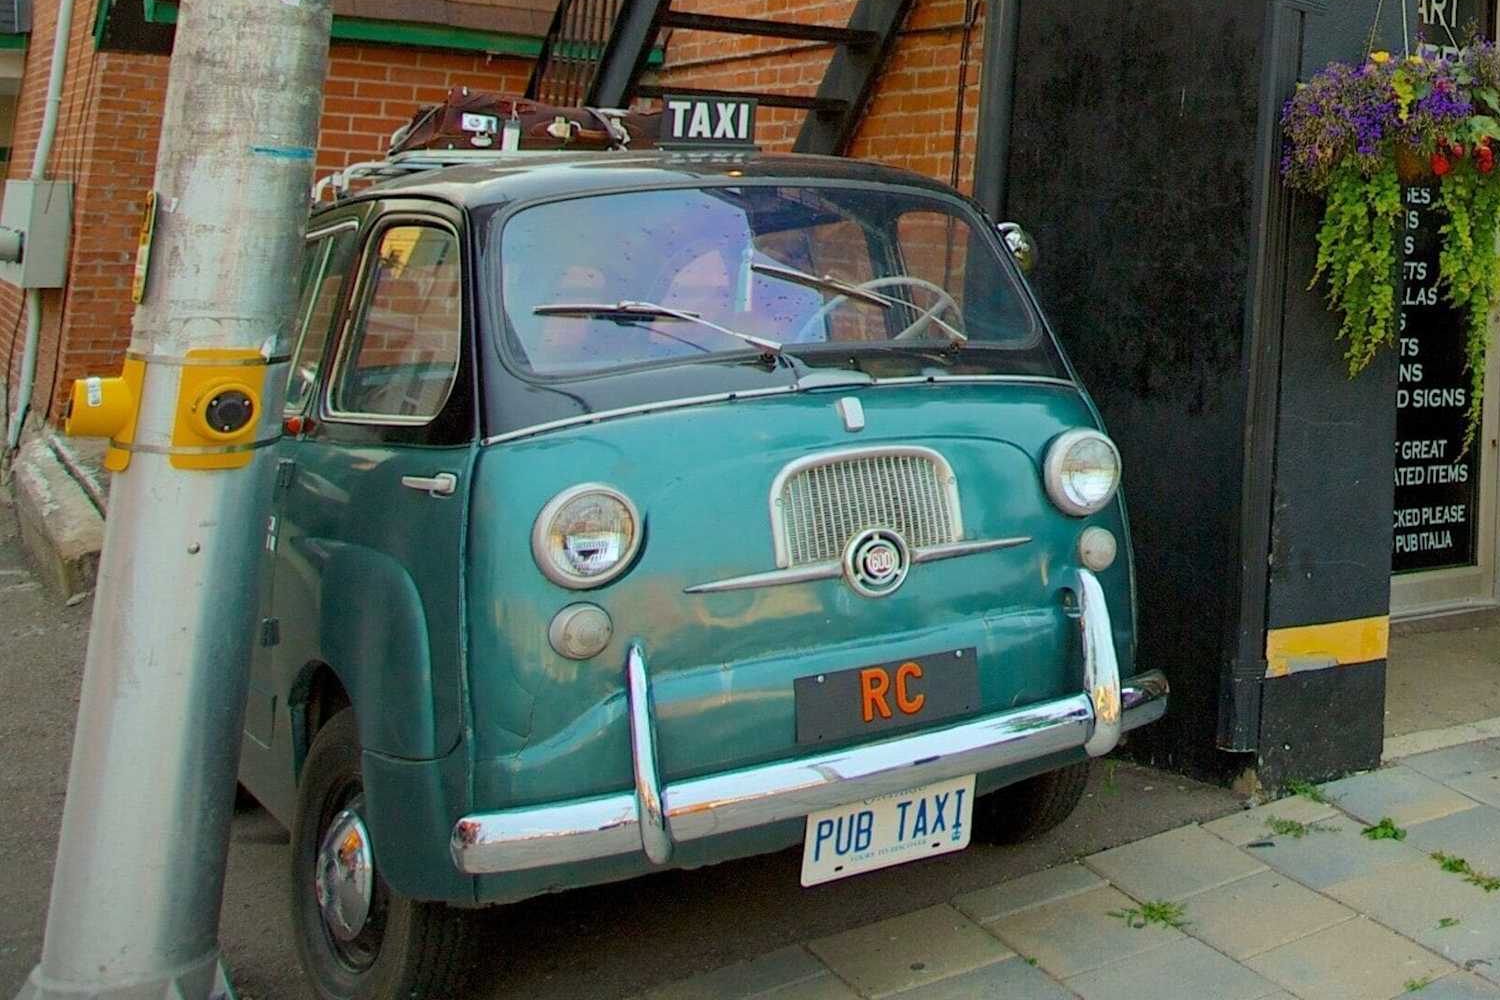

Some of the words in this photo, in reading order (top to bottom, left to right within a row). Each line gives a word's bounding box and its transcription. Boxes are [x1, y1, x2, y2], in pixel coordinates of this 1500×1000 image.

[668, 101, 749, 139] TAXI
[1413, 388, 1466, 408] SIGNS
[1401, 440, 1448, 459] GREAT
[1427, 464, 1468, 484] ITEMS
[1422, 504, 1466, 525] PLEASE
[1395, 533, 1418, 554] PUB
[1420, 530, 1453, 551] ITALIA
[860, 661, 925, 723] RC
[814, 810, 874, 862] PUB
[897, 789, 965, 842] TAXI
